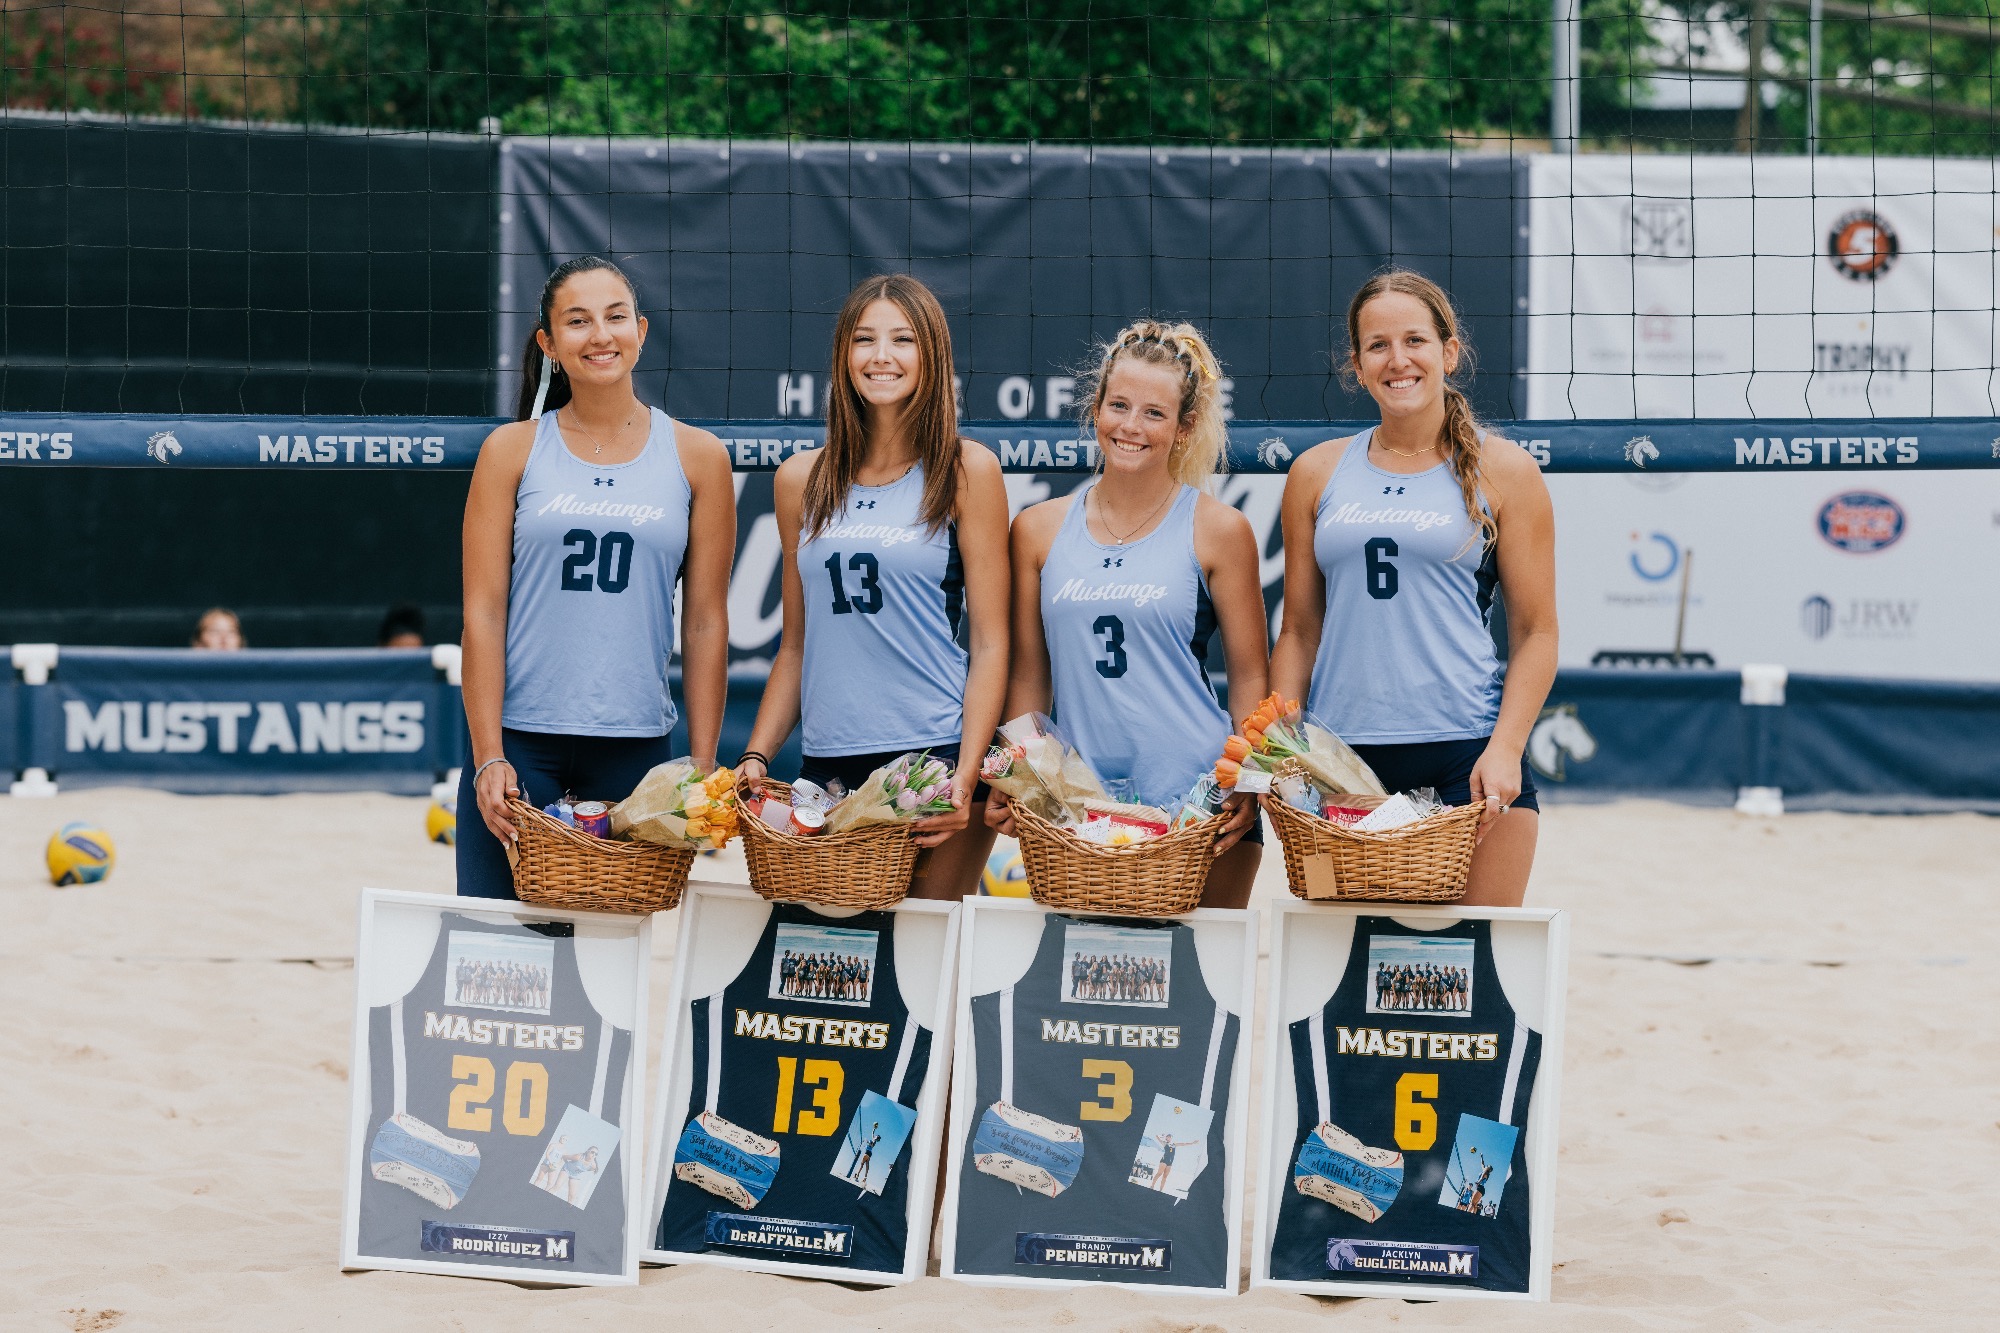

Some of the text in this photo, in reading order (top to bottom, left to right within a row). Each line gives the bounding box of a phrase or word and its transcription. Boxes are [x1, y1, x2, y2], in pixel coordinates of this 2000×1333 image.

[1816, 342, 1908, 378] TROPHY
[997, 376, 1075, 419] OF
[258, 435, 444, 464] MASTER'S
[1734, 437, 1919, 464] MASTER'S
[538, 494, 665, 526] Mustangs
[1324, 503, 1452, 531] Mustangs
[561, 529, 634, 593] 20
[1364, 537, 1398, 600] 6
[825, 552, 883, 614] 13
[1053, 579, 1168, 607] Mustangs
[1093, 615, 1128, 679] 3
[63, 701, 425, 754] MUSTANGS
[424, 1011, 584, 1051] MASTER'S
[735, 1009, 890, 1049] MASTER'S
[1041, 1018, 1181, 1049] MASTER'S
[1336, 1026, 1499, 1061] MASTER'S
[447, 1054, 549, 1137] 20
[772, 1056, 845, 1137] 13
[1080, 1059, 1134, 1123] 3
[1393, 1072, 1440, 1151] 6
[488, 1232, 509, 1241] IZZY
[759, 1224, 798, 1235] ARIANNA
[822, 1230, 847, 1253] M
[452, 1237, 541, 1256] RODRIGUEZ
[545, 1237, 570, 1259] M
[1045, 1248, 1141, 1266] PENBERTHY
[1075, 1242, 1112, 1251] BRANDY
[1140, 1246, 1165, 1268] M
[1381, 1249, 1421, 1260] JACKLYN
[1354, 1257, 1448, 1273] GUGLIELMANA
[1447, 1252, 1474, 1275] M
